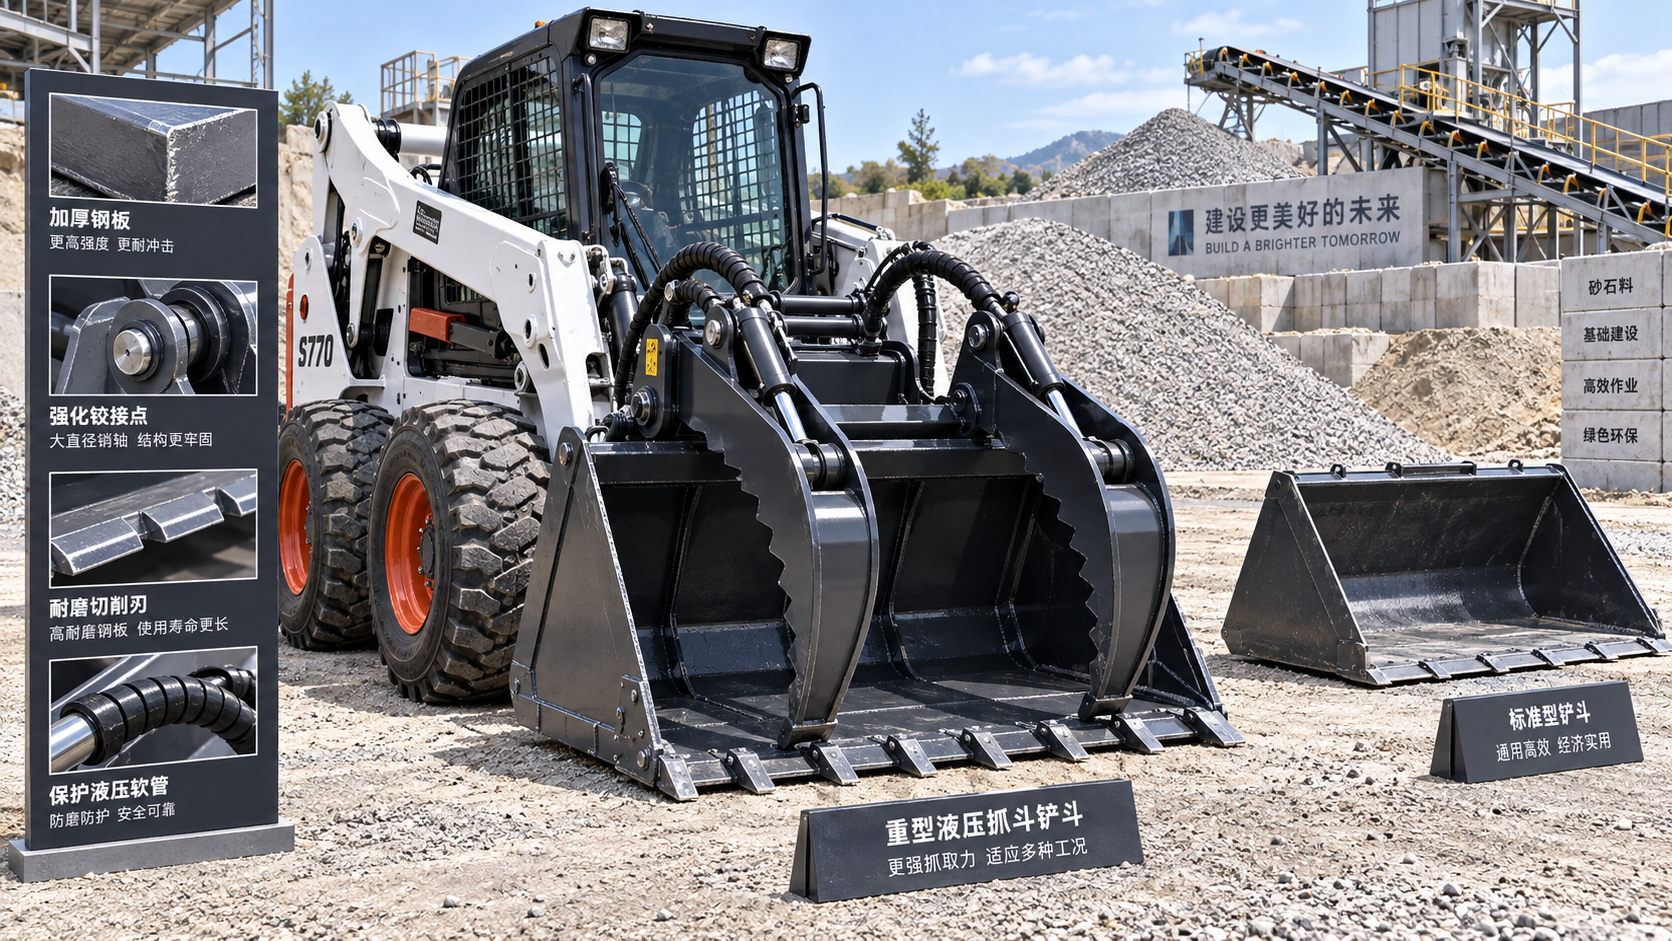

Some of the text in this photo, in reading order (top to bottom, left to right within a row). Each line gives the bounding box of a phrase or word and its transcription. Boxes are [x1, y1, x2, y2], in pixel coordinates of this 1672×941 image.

[49, 207, 130, 230] 加厚钢板
[1205, 193, 1400, 235] 建设更美好的未来
[50, 235, 174, 253] 更高强度 更耐冲击
[1206, 231, 1400, 254] BUILD A BRIGHTER TOMORROW
[1589, 277, 1633, 295] 砂石料
[1584, 325, 1638, 342] 基础建设
[298, 334, 333, 367] S770
[1584, 377, 1638, 394] 高效作业
[50, 406, 147, 426] 强化铰接点
[50, 432, 212, 448] 大直径销轴 结构更牢固
[1584, 427, 1638, 443] 绿色环保
[50, 595, 146, 618] 耐磨切削刃
[50, 617, 228, 641] 高耐磨钢板 使用寿命更长
[1509, 701, 1590, 730] 标准型铲斗
[1496, 732, 1611, 761] 通用高效 经济实用
[49, 776, 169, 806] 保护液压软管
[50, 802, 176, 829] 防磨防护 安全可靠
[885, 800, 1084, 847] 重型液压抓斗铲斗
[888, 837, 1088, 877] 更强抓取力 适应多种工况
